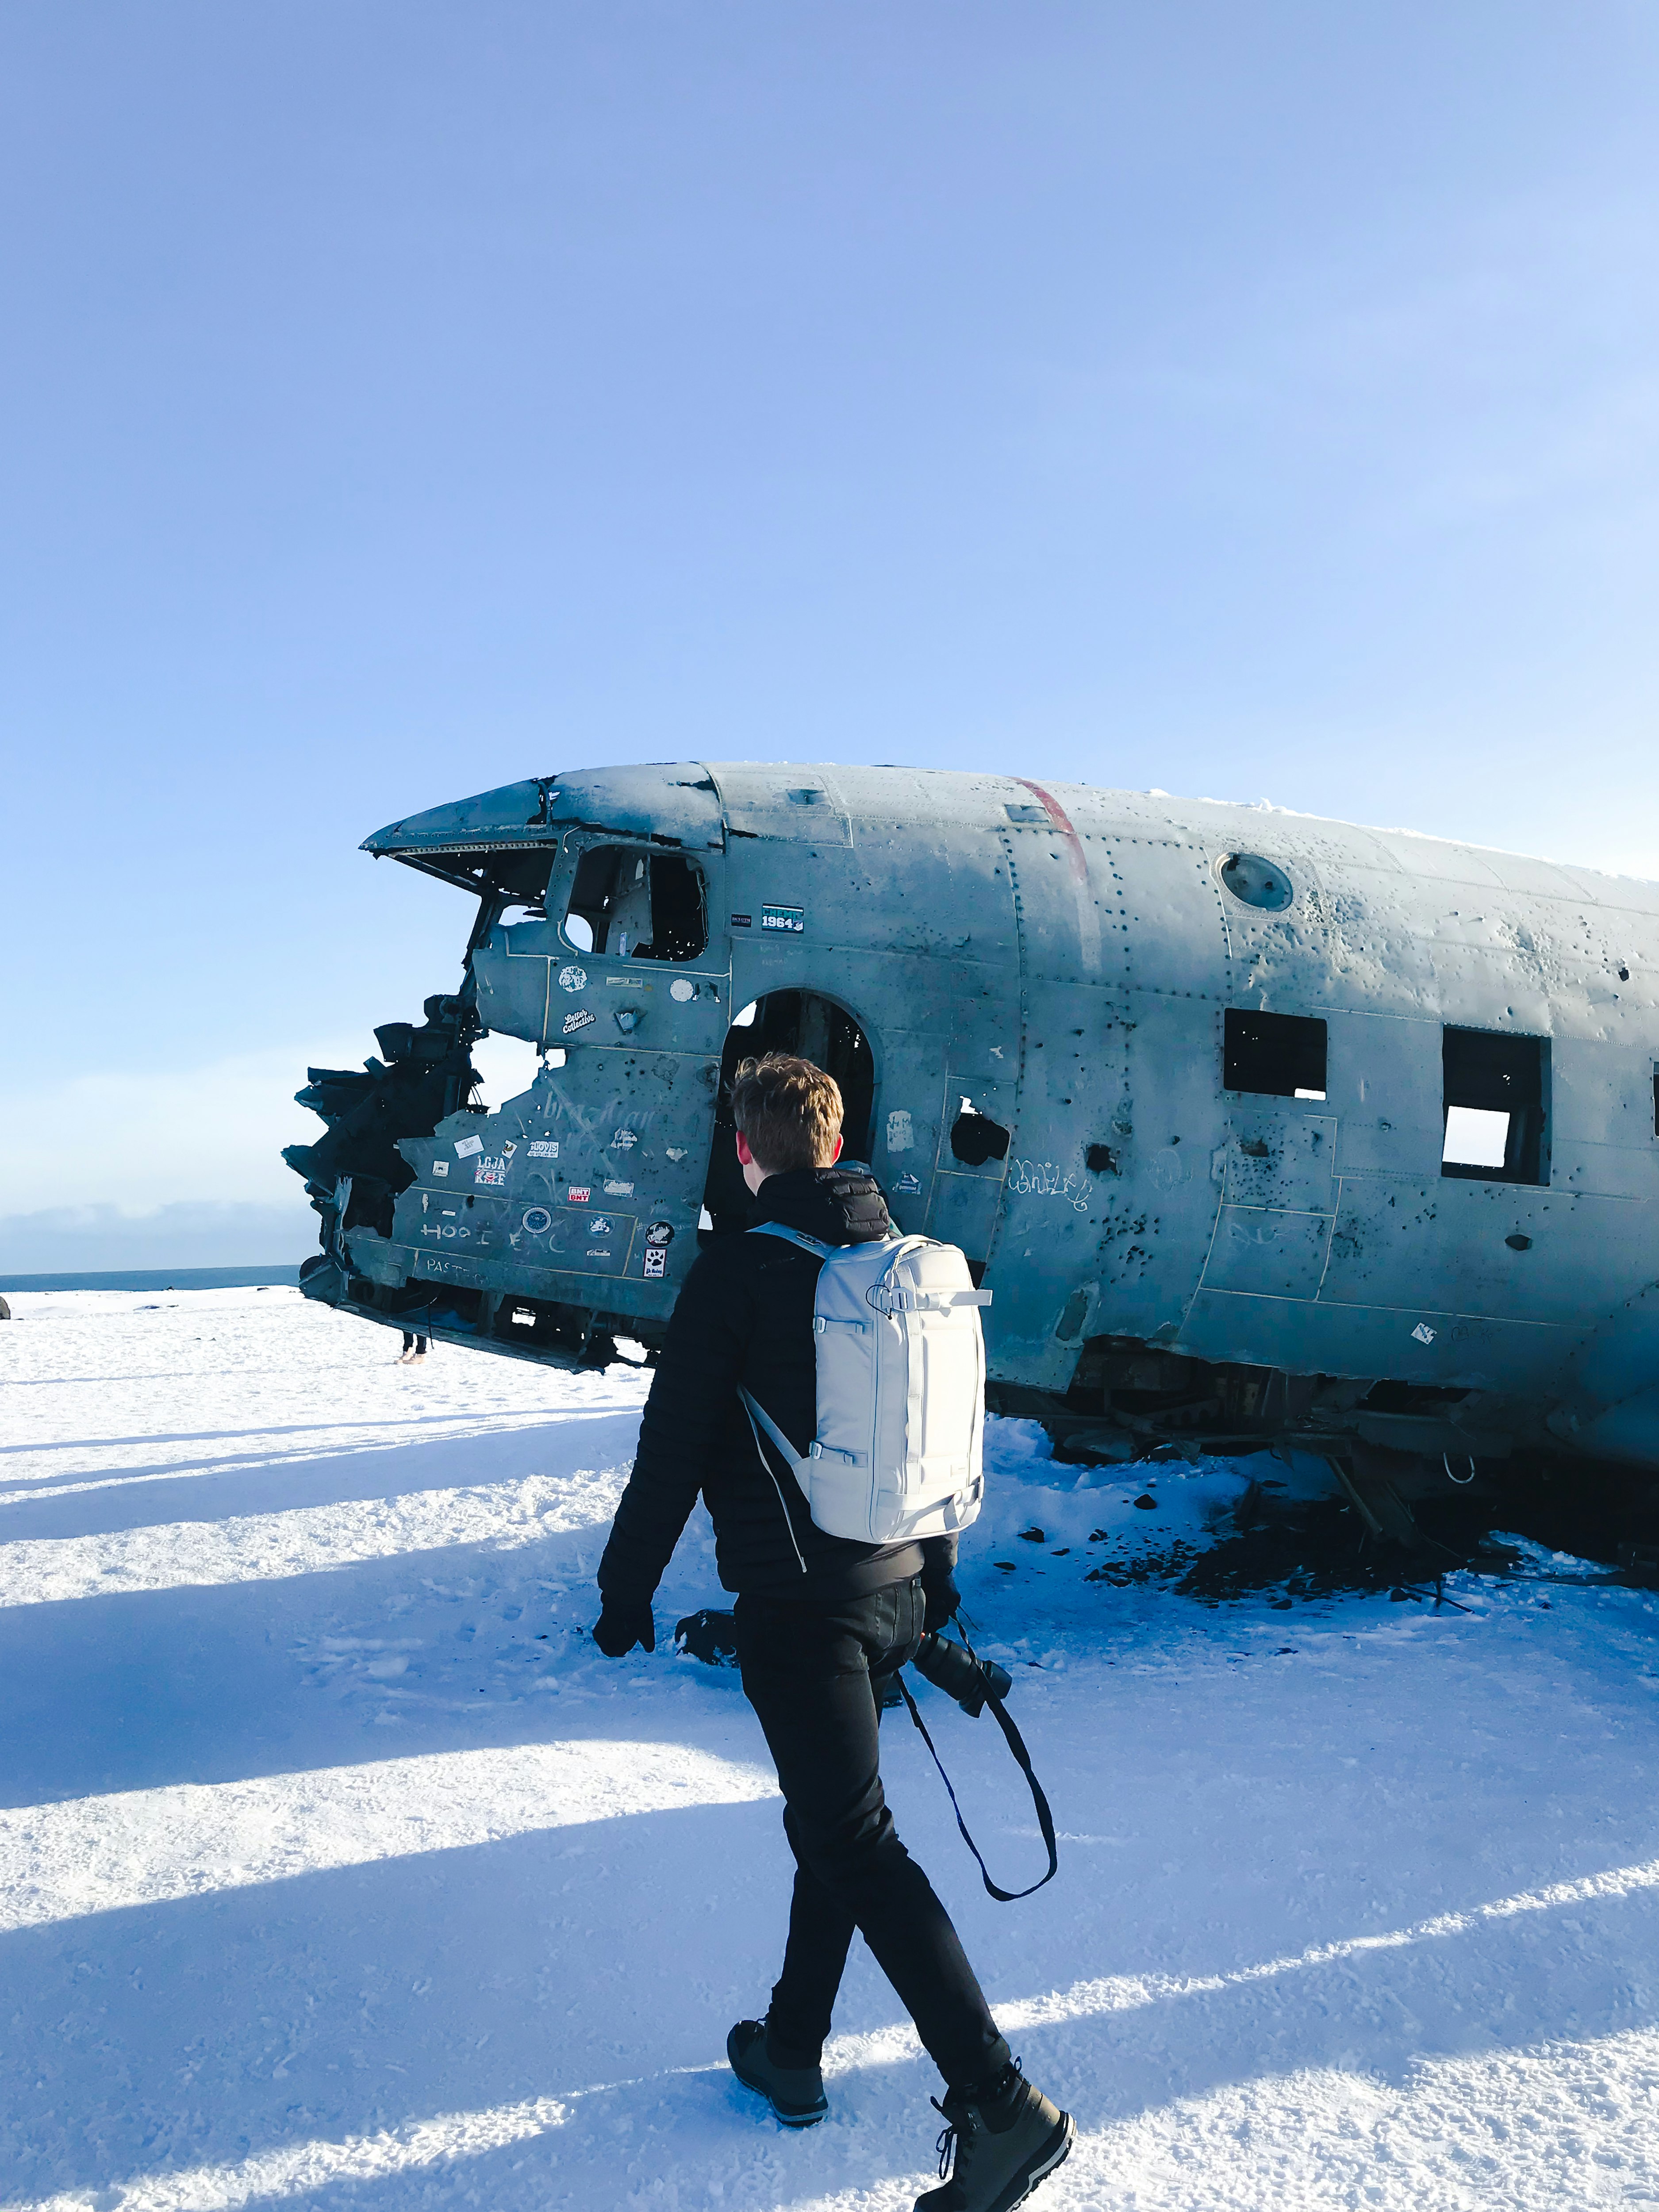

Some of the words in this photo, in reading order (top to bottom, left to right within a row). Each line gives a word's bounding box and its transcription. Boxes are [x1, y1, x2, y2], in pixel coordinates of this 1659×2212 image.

[762, 916, 793, 928] 1964
[562, 1014, 595, 1033] Collective
[565, 1009, 588, 1025] Letter
